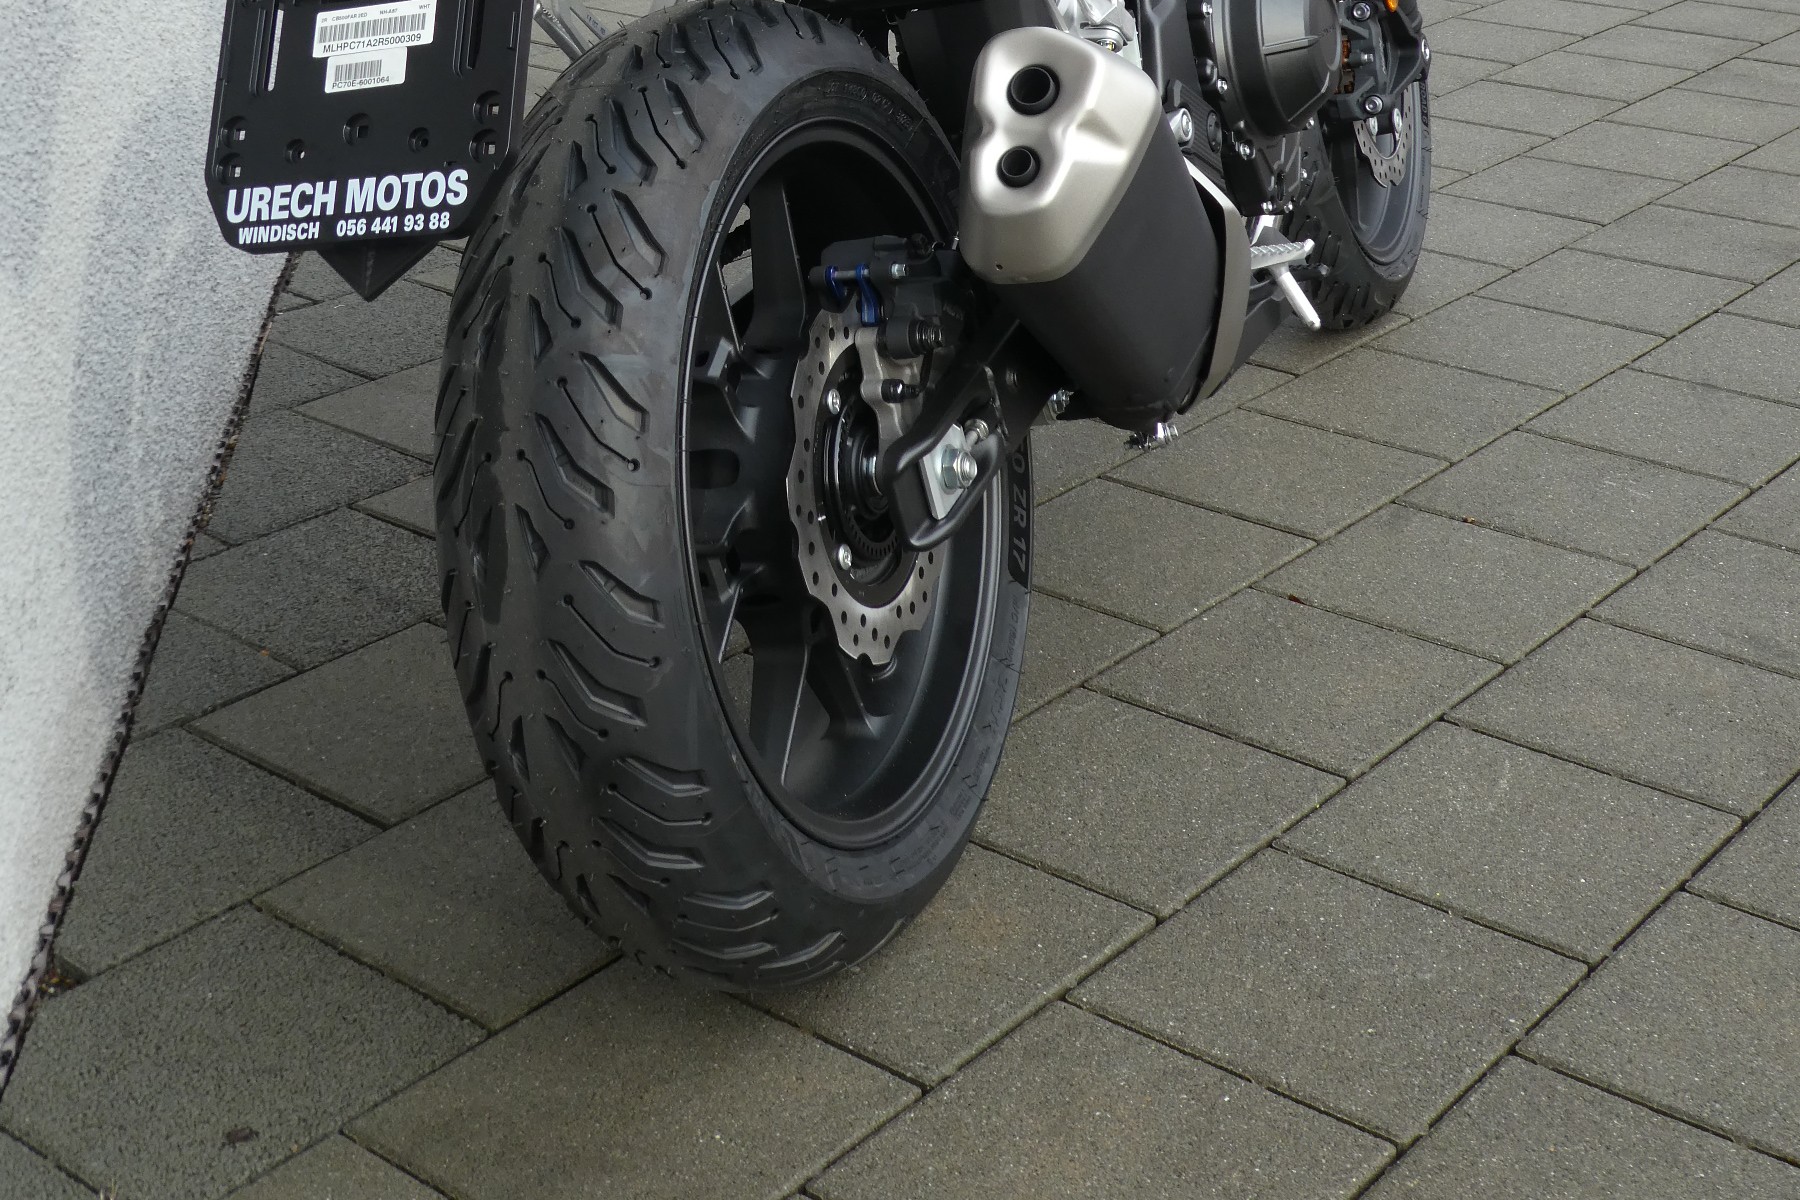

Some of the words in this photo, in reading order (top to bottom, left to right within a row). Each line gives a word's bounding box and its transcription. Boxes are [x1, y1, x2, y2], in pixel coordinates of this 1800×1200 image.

[322, 33, 422, 54] MLHPC71A2R5000309
[226, 180, 337, 224] URECH
[344, 169, 469, 214] MOTOS
[238, 221, 320, 245] WINDISCH
[336, 218, 367, 238] 056
[370, 215, 398, 235] 441
[403, 213, 424, 232] 93
[428, 211, 451, 230] 88
[1013, 483, 1027, 529] ZR
[1013, 536, 1027, 573] 17
